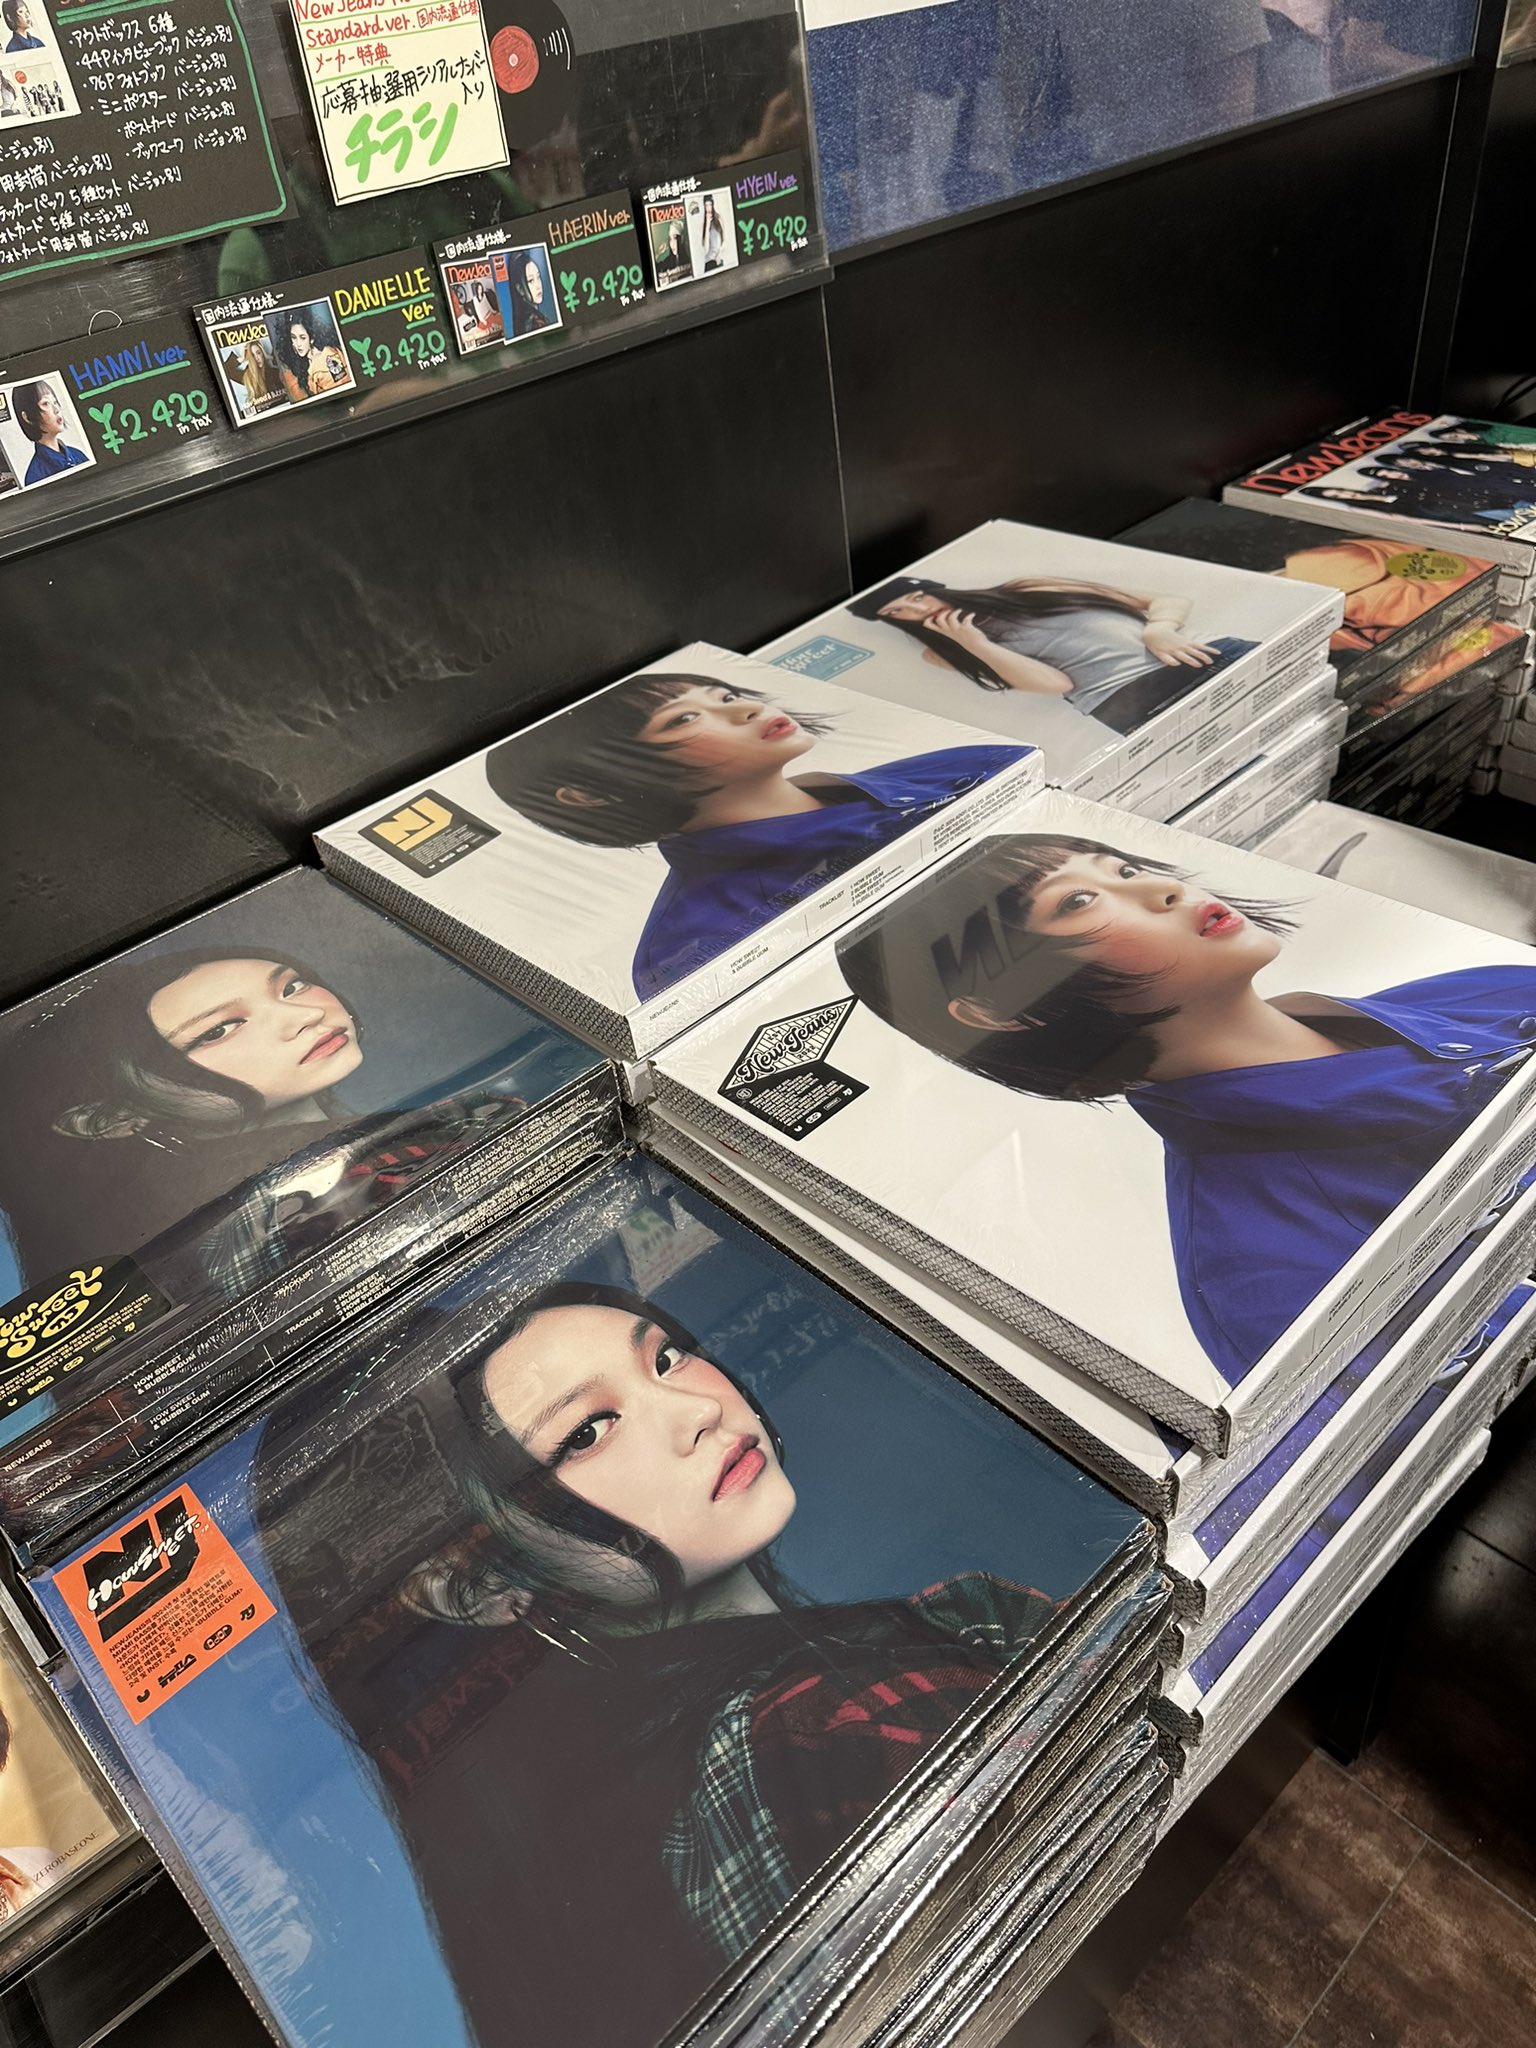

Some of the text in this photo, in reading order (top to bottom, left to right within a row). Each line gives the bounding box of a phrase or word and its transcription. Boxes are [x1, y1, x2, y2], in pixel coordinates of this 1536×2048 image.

[148, 11, 177, 34] 6種
[306, 14, 384, 48] Standard
[315, 43, 391, 73] メーカー特典
[462, 81, 484, 105] 入り
[345, 101, 459, 183] チラシ
[736, 171, 778, 199] HYEIN
[548, 209, 631, 246] HAERIN ver
[334, 267, 431, 316] DANIELLE
[401, 301, 434, 322] ver
[68, 340, 187, 391] HANNI ver
[191, 413, 213, 432] tax
[328, 1247, 346, 1261] HOW
[347, 1231, 371, 1249] SWEET
[338, 1287, 355, 1300] HOW
[356, 1271, 379, 1288] SWEET
[340, 1286, 367, 1305] BUBBLE
[343, 1298, 360, 1311] HOW
[361, 1282, 384, 1299] SWEET
[285, 1307, 324, 1334] TRACKLIST
[133, 1354, 182, 1388] HOW SWEET
[136, 1354, 196, 1395] & BUBBLE GUM
[149, 1391, 196, 1423] HOW SWEET
[152, 1390, 210, 1430] & BUBBLE GUM
[4, 1438, 52, 1472] NEWJEANS
[26, 1474, 71, 1506] NEWJEANS
[111, 1639, 133, 1657] MIAMI
[33, 1831, 99, 1882] ZEROBASEONE
